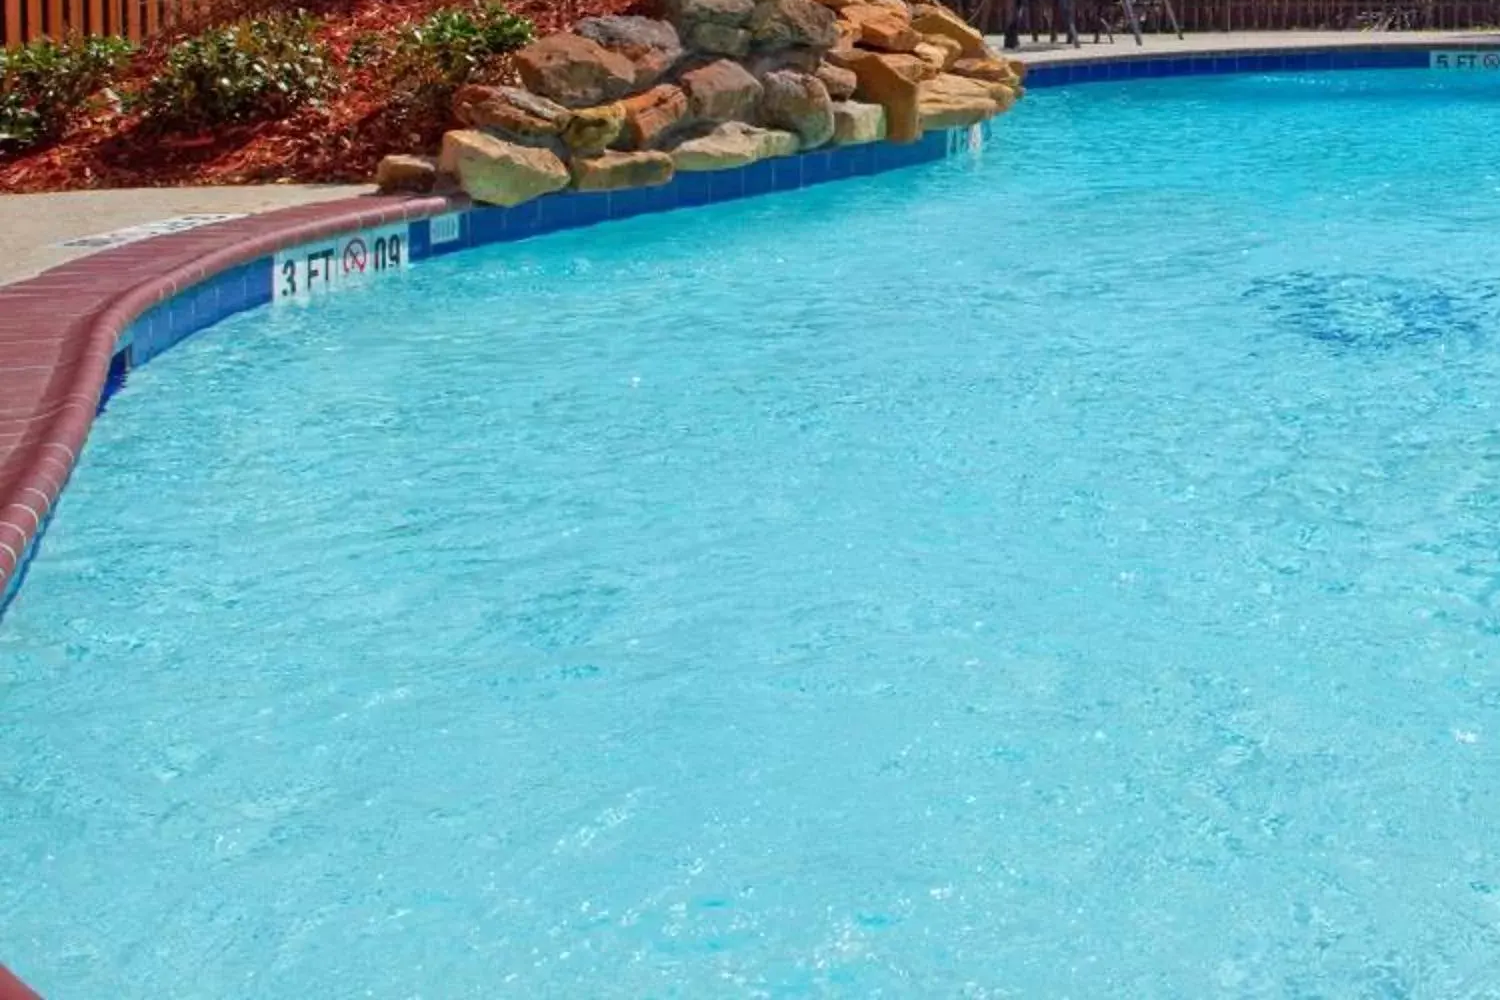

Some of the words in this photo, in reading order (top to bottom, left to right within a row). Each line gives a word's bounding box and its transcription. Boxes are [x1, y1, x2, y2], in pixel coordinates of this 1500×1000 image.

[1456, 54, 1477, 69] FT
[281, 259, 297, 297] 3
[307, 247, 336, 291] FT
[374, 234, 402, 272] 09
